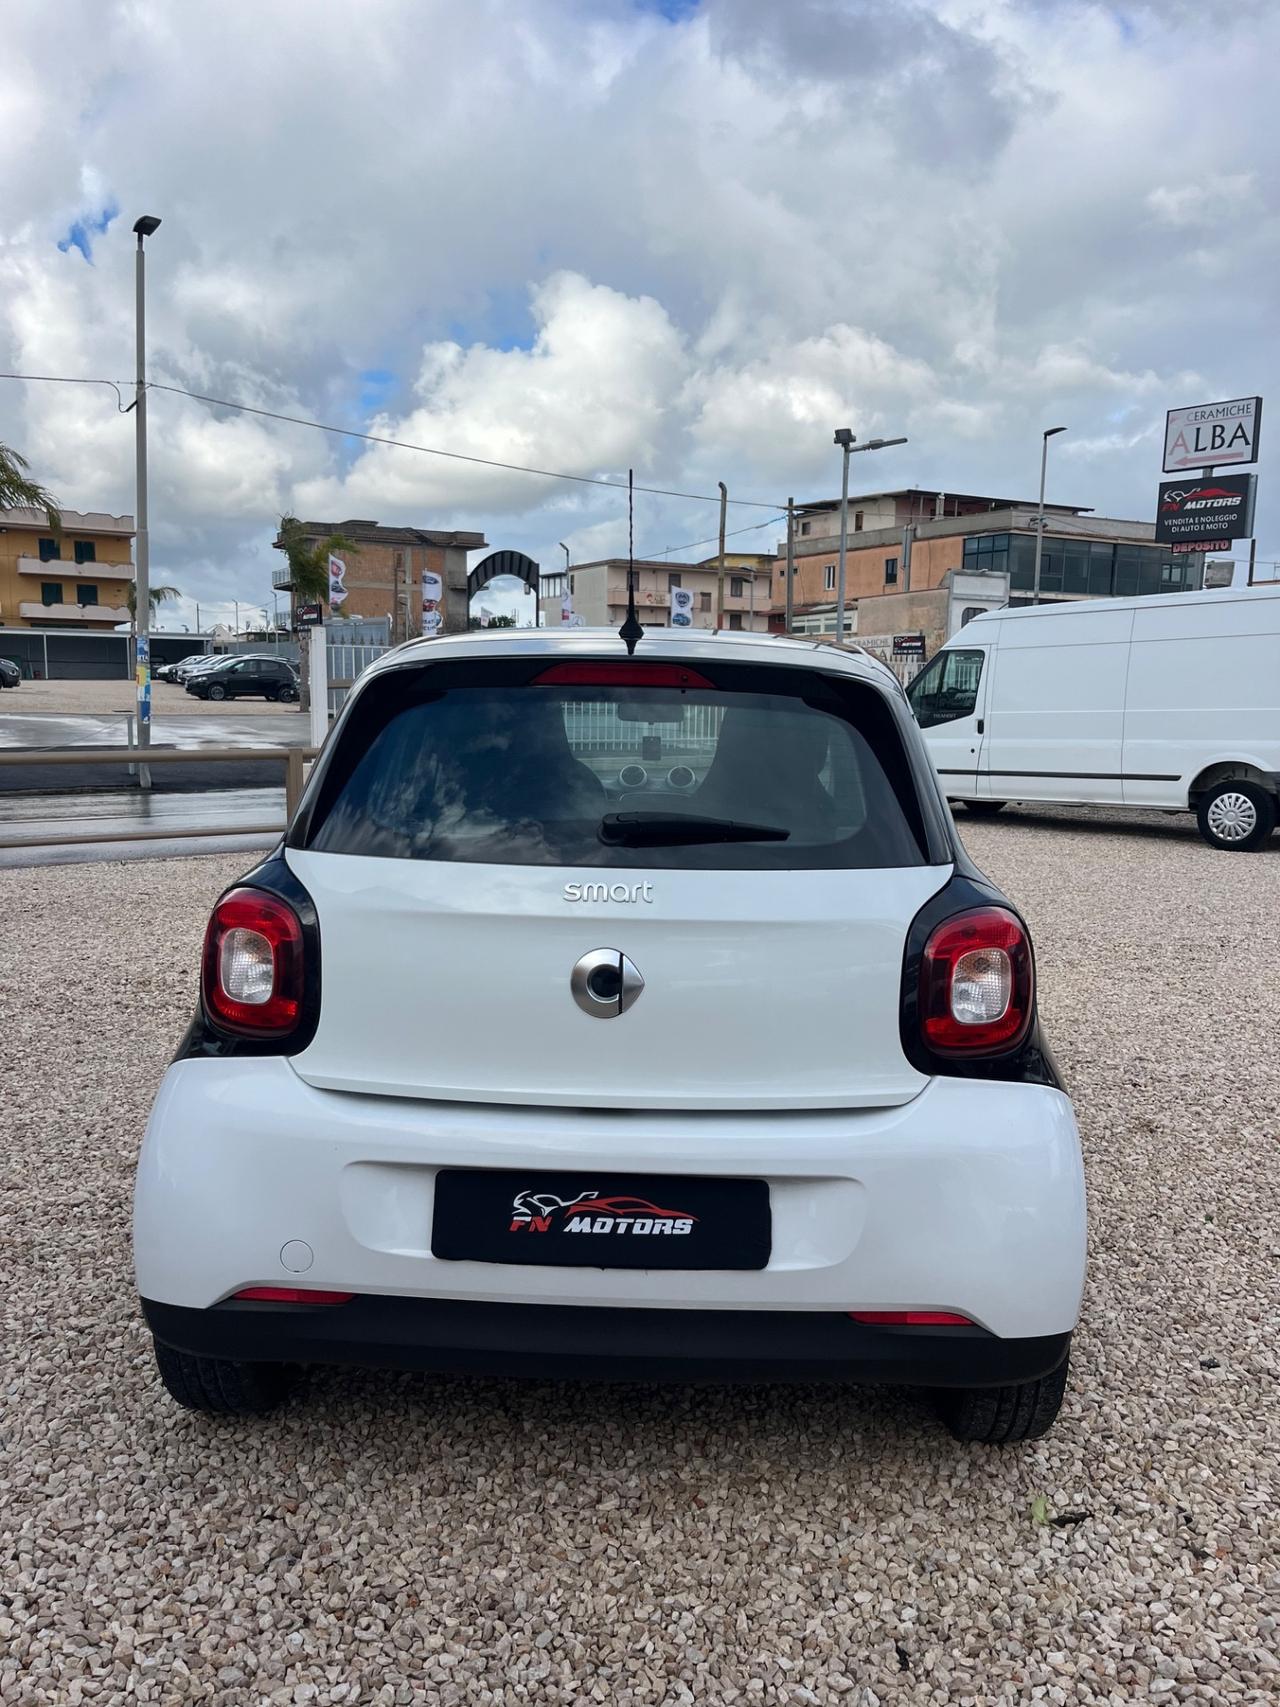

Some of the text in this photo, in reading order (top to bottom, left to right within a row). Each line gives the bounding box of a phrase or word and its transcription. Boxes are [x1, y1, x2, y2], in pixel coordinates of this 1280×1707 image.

[1186, 403, 1252, 422] CERAMICHE
[1168, 422, 1251, 456] ALBA
[1184, 497, 1242, 510] MOTORS
[1164, 517, 1194, 526] VENDITA
[1200, 513, 1238, 523] NOLEGGIO
[1180, 523, 1200, 533] AUTO
[1201, 523, 1205, 531] E
[1206, 522, 1228, 531] MOTO
[1172, 540, 1229, 553] DEPOSITO
[563, 880, 654, 904] smart
[509, 1216, 694, 1235] FN MOTORS
